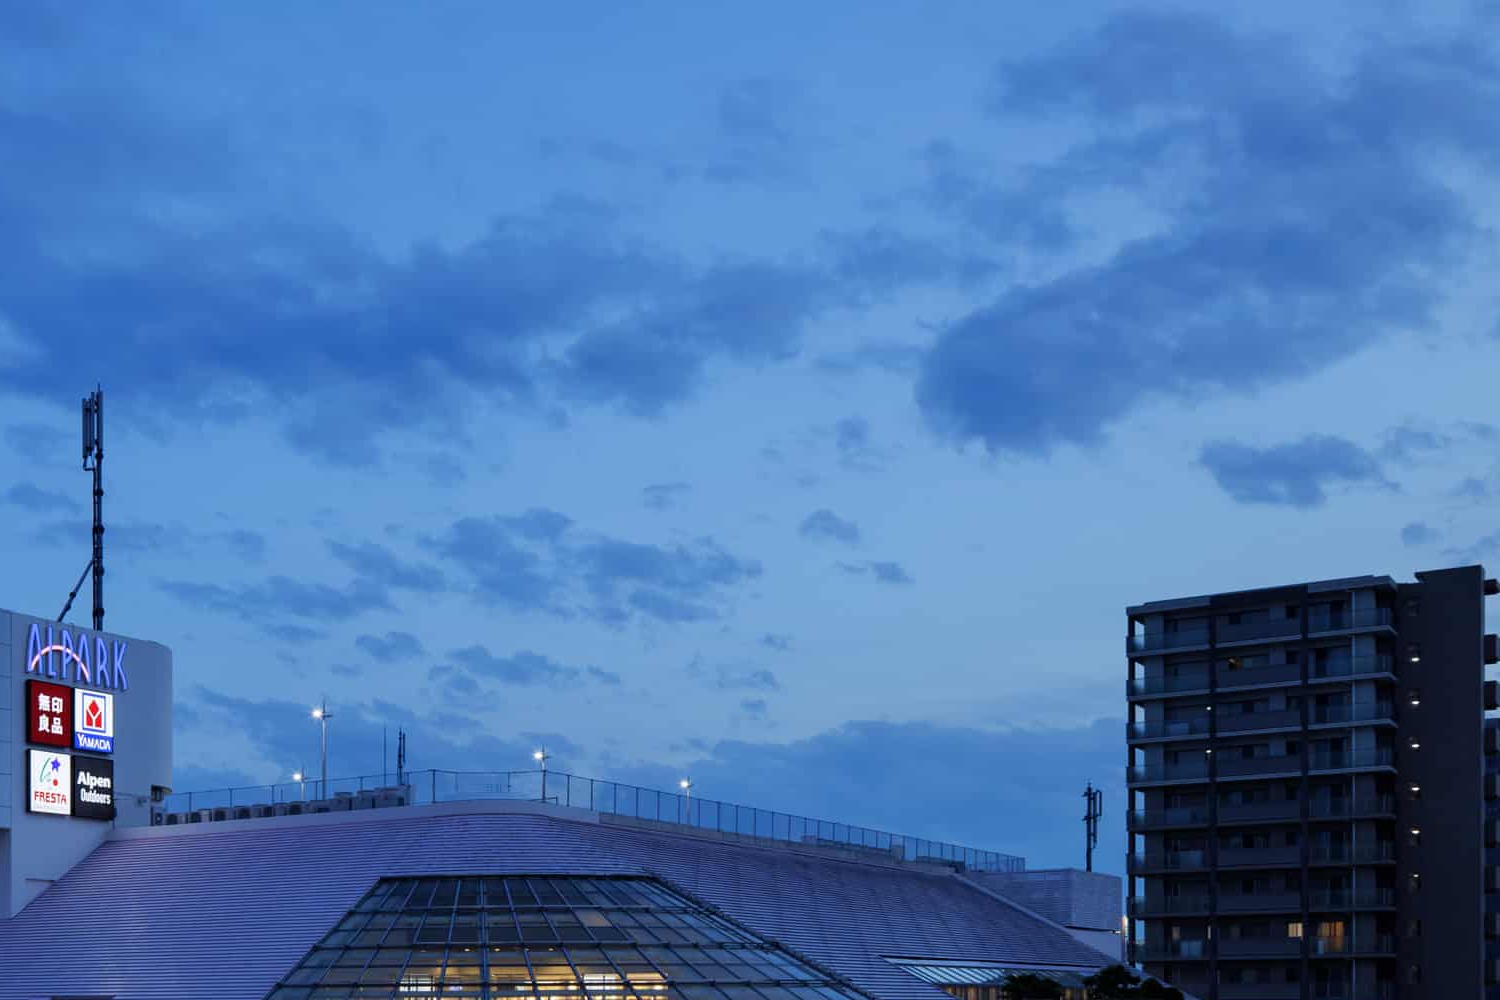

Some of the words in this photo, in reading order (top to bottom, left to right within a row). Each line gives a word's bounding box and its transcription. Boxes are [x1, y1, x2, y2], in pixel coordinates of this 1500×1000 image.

[26, 622, 129, 690] ALPARK
[38, 693, 63, 714] 無印
[38, 715, 63, 735] 良品
[77, 734, 111, 752] YAMADA
[77, 771, 111, 790] Alpen
[34, 790, 67, 806] FRESTA
[80, 788, 111, 805] Outdoors
